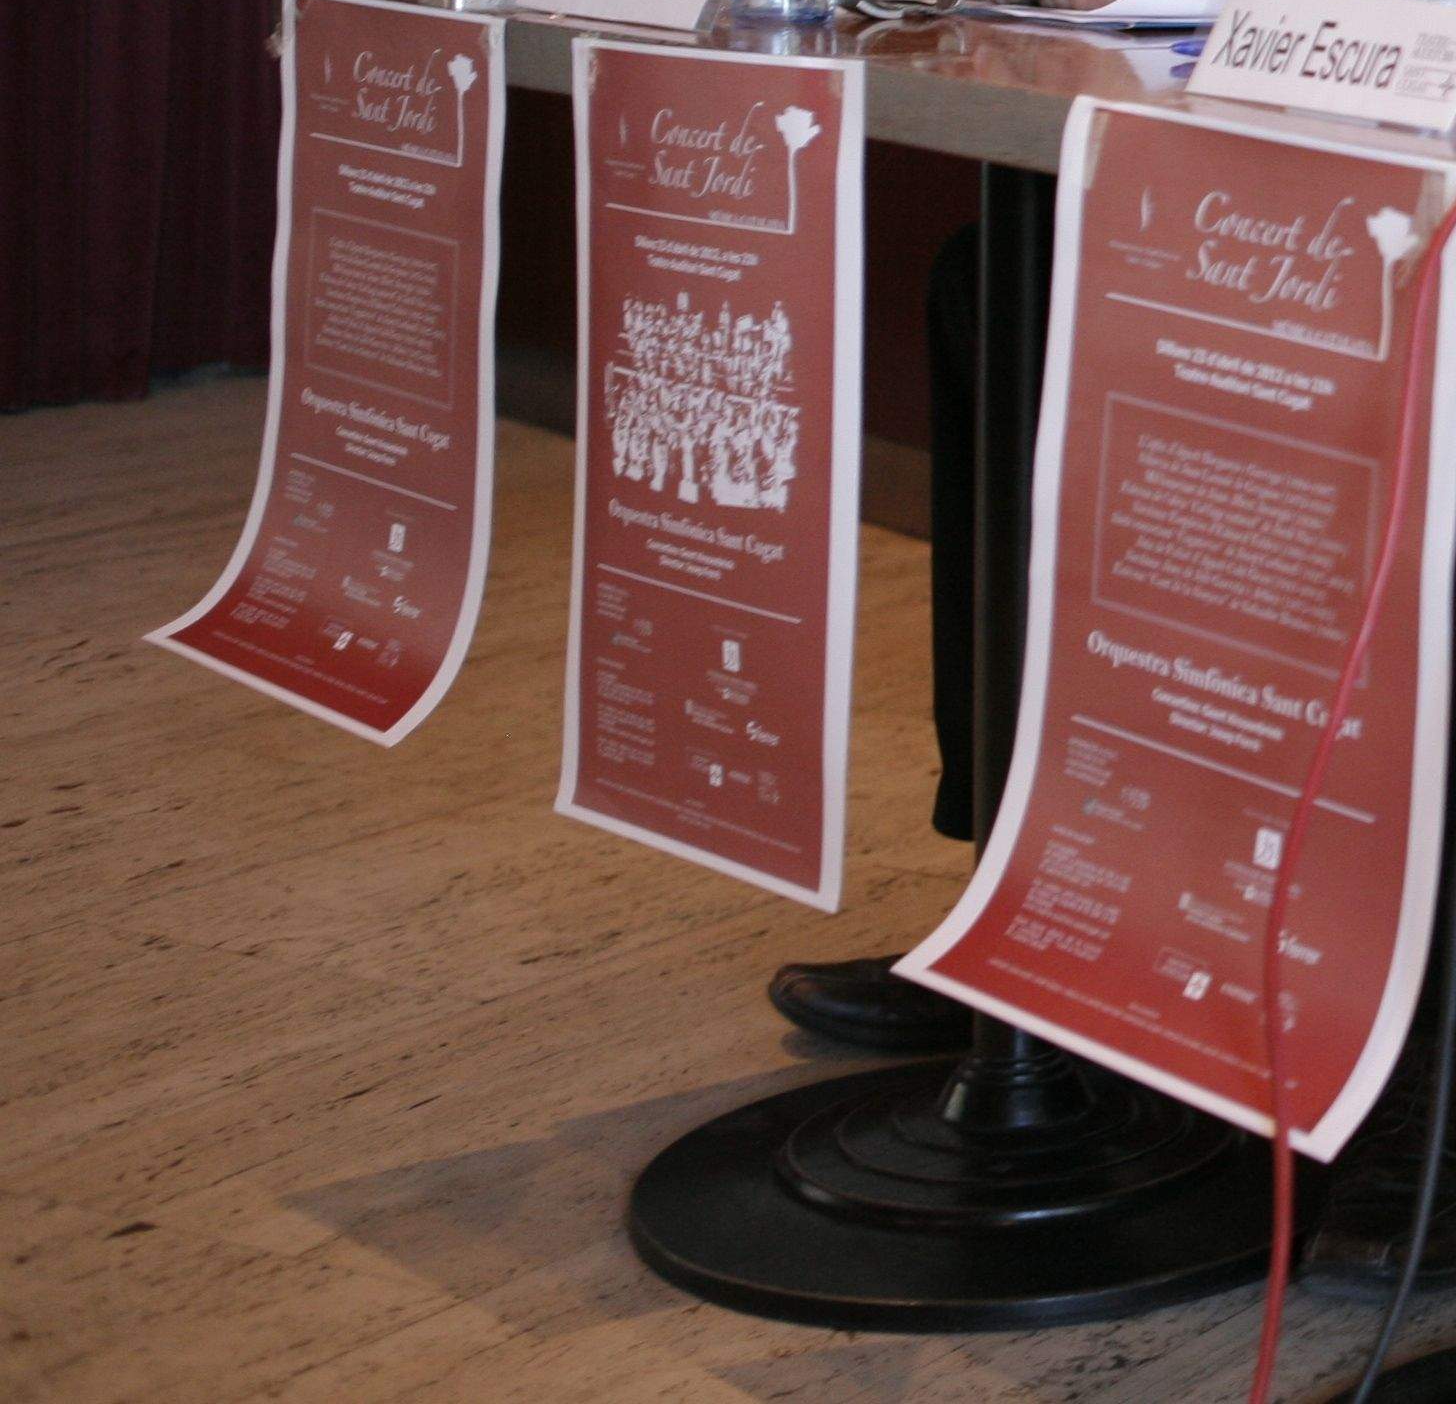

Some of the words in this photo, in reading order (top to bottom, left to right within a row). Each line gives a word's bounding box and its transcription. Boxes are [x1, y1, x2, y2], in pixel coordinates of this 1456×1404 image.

[353, 50, 415, 90] Concert
[416, 48, 442, 95] de
[1210, 10, 1305, 75] Xavier
[1300, 21, 1401, 88] Escura
[353, 87, 390, 122] Sant
[387, 91, 440, 134] Jordi
[652, 109, 727, 150] Concert
[730, 101, 764, 156] de
[650, 150, 695, 188] Sant
[690, 145, 763, 200] Jordi
[1194, 191, 1306, 251] Concert
[1306, 196, 1355, 261] de
[1186, 240, 1259, 291] Sant
[1250, 249, 1353, 312] Jordi
[1087, 630, 1171, 678] Orquestra
[1260, 684, 1302, 720] Sant
[1304, 698, 1363, 740] Cuat
